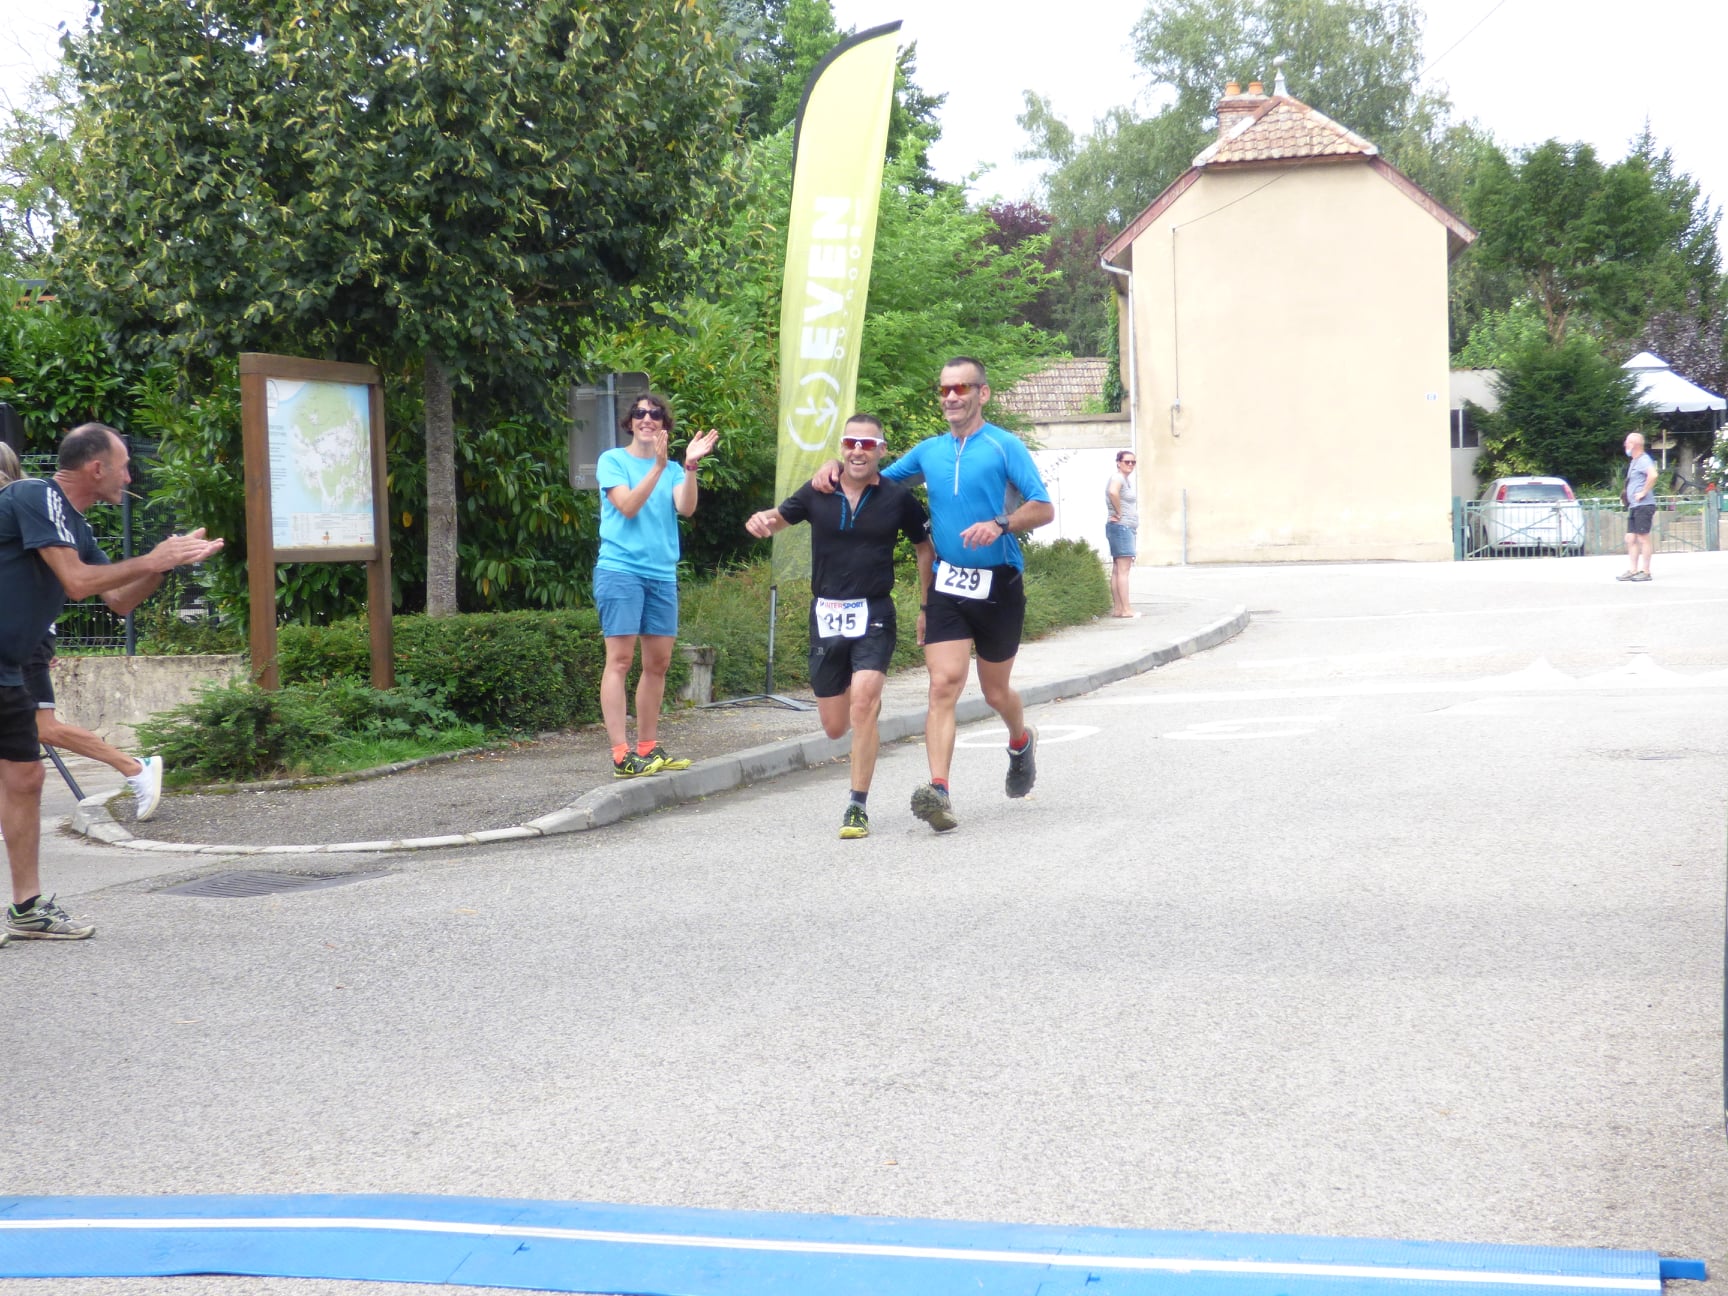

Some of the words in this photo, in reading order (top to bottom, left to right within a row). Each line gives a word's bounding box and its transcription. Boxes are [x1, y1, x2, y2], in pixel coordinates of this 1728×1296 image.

[800, 196, 851, 359] EVEN
[944, 569, 981, 591] 229
[825, 601, 864, 609] INTERSPORT
[824, 613, 856, 632] 215
